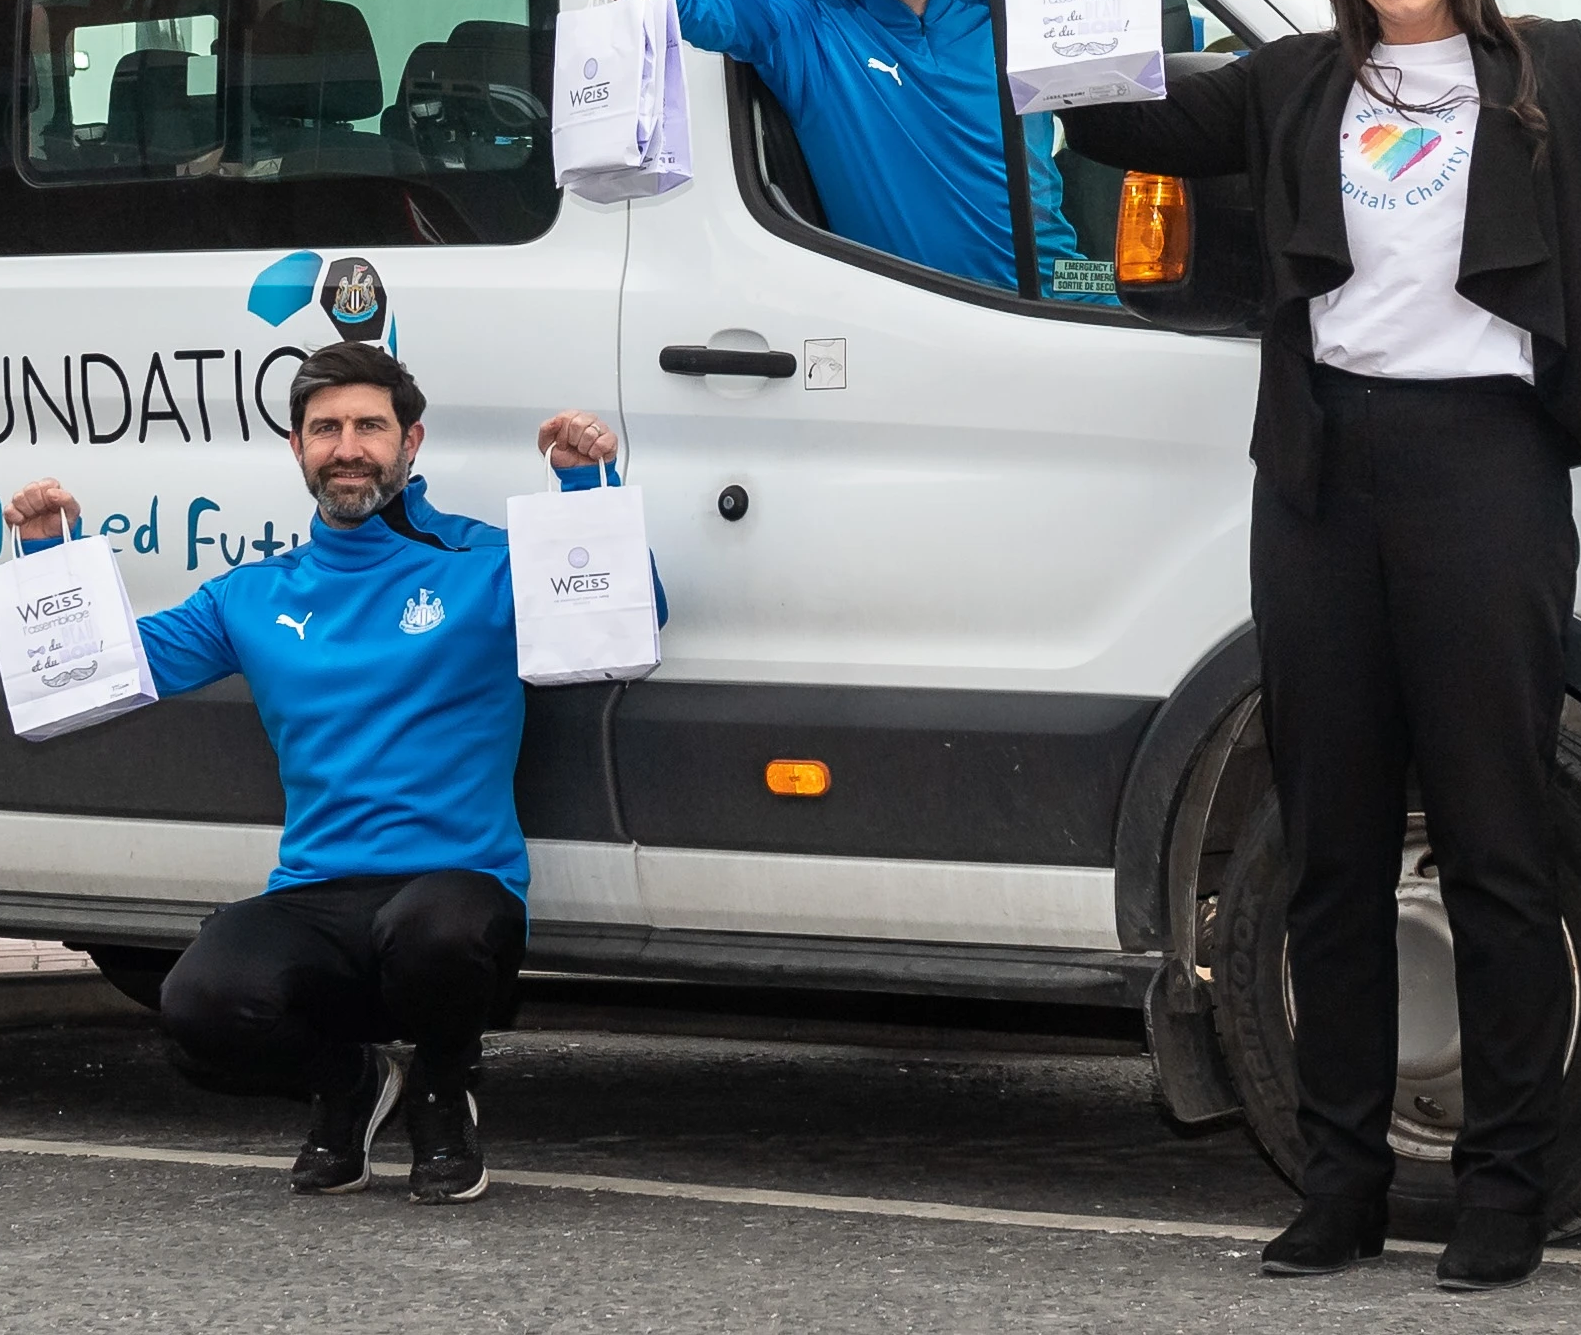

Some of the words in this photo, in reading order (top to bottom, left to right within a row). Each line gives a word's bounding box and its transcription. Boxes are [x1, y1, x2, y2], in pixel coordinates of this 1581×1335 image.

[1067, 10, 1084, 22] du
[1059, 24, 1076, 37] du
[570, 81, 610, 107] Weiss
[1341, 173, 1397, 210] pitals
[1406, 145, 1470, 207] Charity
[1064, 261, 1108, 272] EMERGENCY
[1054, 271, 1079, 280] SALIDA
[1079, 272, 1089, 281] DE
[1090, 273, 1115, 282] EMERG
[1058, 281, 1083, 290] SORTIE
[1084, 282, 1094, 290] DE
[1096, 282, 1115, 292] SECO
[187, 496, 300, 571] Fut
[550, 572, 610, 595] Weiss
[23, 609, 90, 635] l'assemblage
[49, 638, 63, 652] du
[31, 657, 42, 673] et
[44, 655, 59, 669] du
